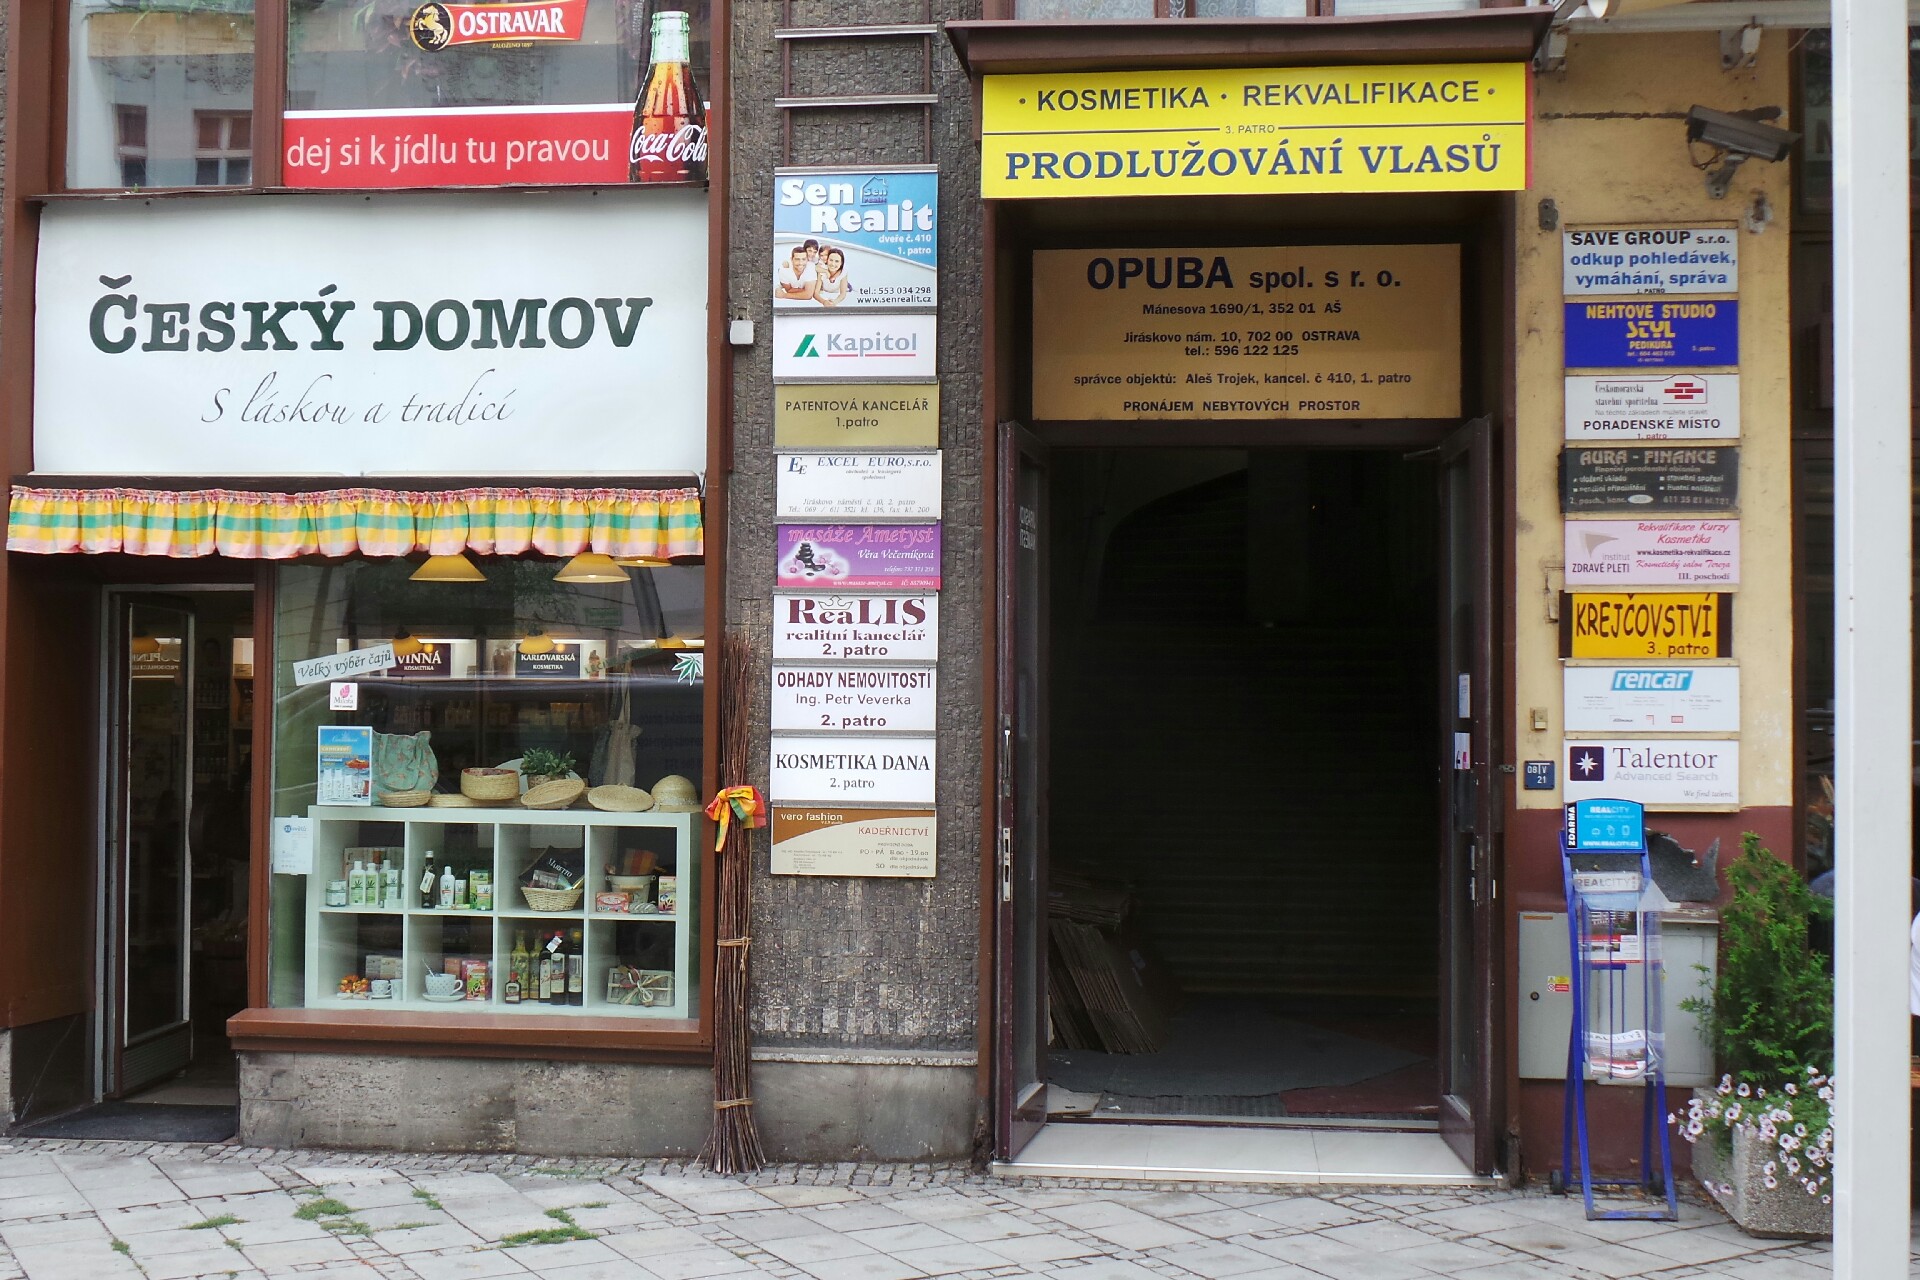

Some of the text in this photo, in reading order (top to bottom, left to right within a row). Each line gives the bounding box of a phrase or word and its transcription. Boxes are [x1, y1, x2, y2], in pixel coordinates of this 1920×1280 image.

[458, 7, 566, 36] OSTRAVAR
[1037, 80, 1480, 113] KOSMETIKA REKVALIFIKACE
[1225, 123, 1275, 135] 3. PATRO
[629, 124, 708, 164] Coca-Cola
[286, 133, 610, 175] dej si k jídlu tu pravou
[1005, 133, 1501, 181] PRODLUŽOVÁNÍ VLASŮ
[780, 178, 854, 206] Sen
[810, 199, 933, 233] Realit
[879, 234, 904, 244] dveře
[914, 234, 931, 243] 410
[1570, 230, 1730, 246] SAVE GROUP s.r.o.
[897, 246, 931, 256] 1. patro
[1570, 250, 1736, 267] odkup pohledávek,
[1087, 256, 1401, 293] OPUBA spol. s r. o.
[1576, 271, 1727, 288] vymáhání, správa
[878, 286, 895, 295] 553
[896, 286, 913, 295] 034
[914, 286, 931, 294] 298
[856, 295, 932, 303] www.senrealit.cz
[89, 274, 653, 354] ČESKÝ DOMOV
[1143, 300, 1342, 316] Mánesova 1690/1, 352 01 AŠ
[1662, 303, 1716, 318] STUDIO
[827, 331, 917, 357] Kapitol
[1123, 330, 1360, 343] Jiráskovo nám. 10, 702 00 OSTRAVA
[1184, 345, 1299, 356] tel.: 596 122 125
[1073, 373, 1122, 386] správce
[1126, 372, 1177, 386] objektů:
[1185, 373, 1213, 384] Aleš
[1217, 373, 1259, 385] Trojek,
[1264, 373, 1310, 384] kancel.
[1327, 372, 1356, 385] 410,
[1360, 373, 1373, 383] 1.
[1378, 373, 1412, 385] patro
[200, 368, 515, 425] S láskou a tradicí
[785, 397, 929, 411] PATENTOVÁ KANCELÁŘ
[1123, 398, 1360, 411] PRONÁJEM NEBYTOVÝCH PROSTOR
[1583, 416, 1721, 431] PORADENSKÉ MÍSTO
[817, 456, 859, 467] EXCEL
[1579, 450, 1718, 465] AURA FINANCE
[1637, 522, 1730, 533] Rekvalifikace Kurzy
[787, 526, 934, 549] masáže Ametyst
[1657, 534, 1711, 544] Kosmetika
[857, 549, 934, 560] Věra Večerníková
[1602, 553, 1630, 561] institut
[1572, 562, 1604, 573] ZDRAVÉ
[1678, 572, 1730, 581] III. poschodí
[1576, 593, 1712, 638] KREJČOVSTVÍ
[786, 629, 926, 641] realitní kancelář
[520, 653, 576, 661] KARLOVARSKÁ
[822, 643, 888, 658] 2. patro
[1647, 641, 1710, 658] 3. patro
[297, 650, 393, 678] Velký výběr čajů
[777, 668, 932, 689] ODHADY NEMOVITOSTÍ
[1614, 671, 1689, 689] rencar
[795, 693, 911, 707] Ing. Petr Veverka
[820, 714, 887, 729] 2. patro
[775, 754, 931, 771] KOSMETIKA DANA
[1612, 747, 1718, 769] Talentor
[829, 777, 875, 790] 2. patro
[1537, 775, 1546, 784] 21
[1614, 771, 1718, 781] Advanced Search
[780, 812, 843, 821] vero fashion
[858, 825, 929, 836] KADEŘNICTVÍ
[1568, 806, 1576, 846] ZDARMA
